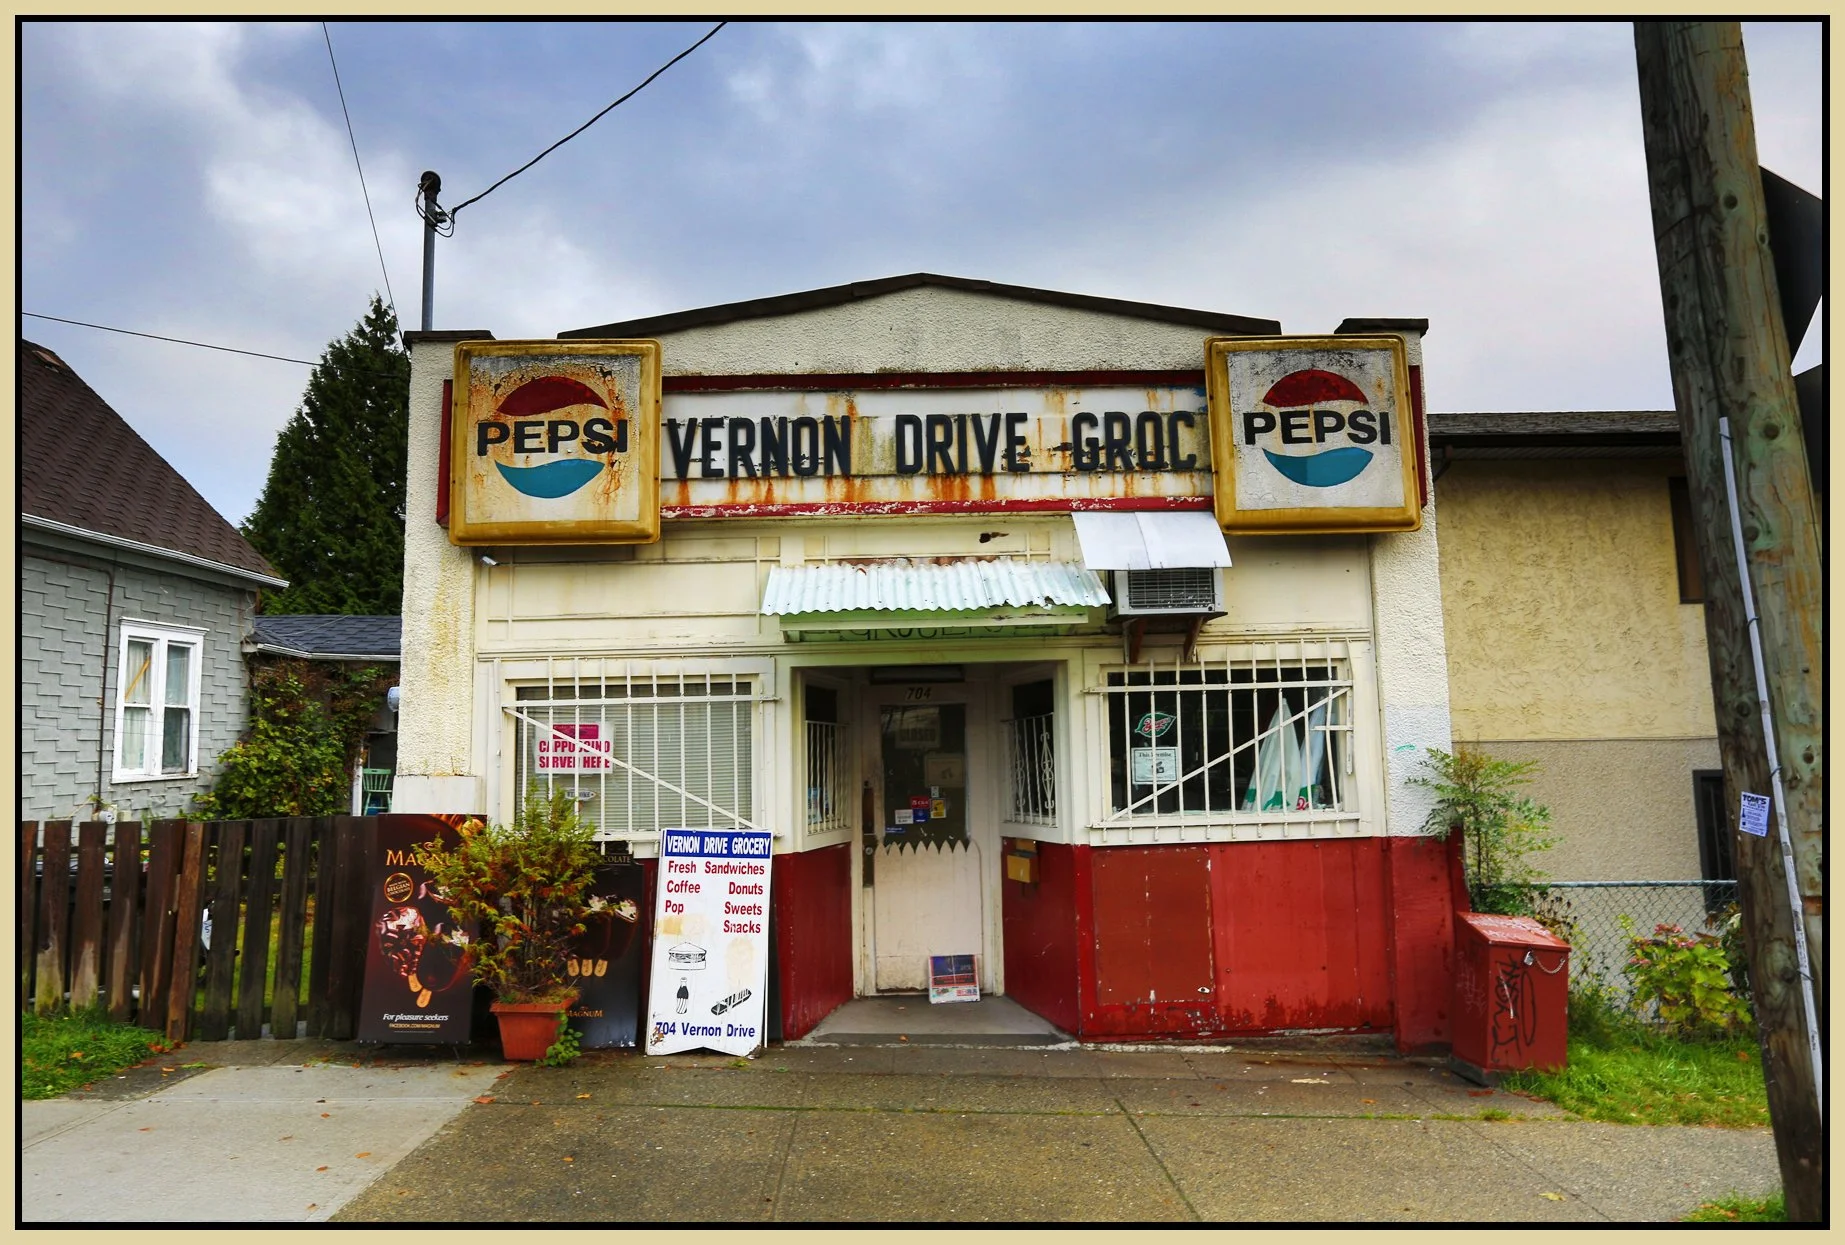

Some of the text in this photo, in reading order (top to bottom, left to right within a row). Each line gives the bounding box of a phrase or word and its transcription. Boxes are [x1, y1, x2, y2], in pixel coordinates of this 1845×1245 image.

[1243, 410, 1392, 445] PEPSI
[477, 418, 629, 456] PEPSI
[667, 411, 1197, 480] VERNON DRIVE GROC
[907, 687, 932, 700] 704
[667, 835, 770, 855] VERNON DRIVE GROCERY
[668, 860, 765, 875] Fresh Sandwiches
[667, 880, 763, 895] Coffee Donuts
[665, 900, 762, 915] Pop Sweets
[723, 920, 761, 934] Snacks
[383, 1013, 396, 1021] For
[394, 1013, 424, 1022] pleasure
[656, 1022, 756, 1038] 704 Vernon Drive
